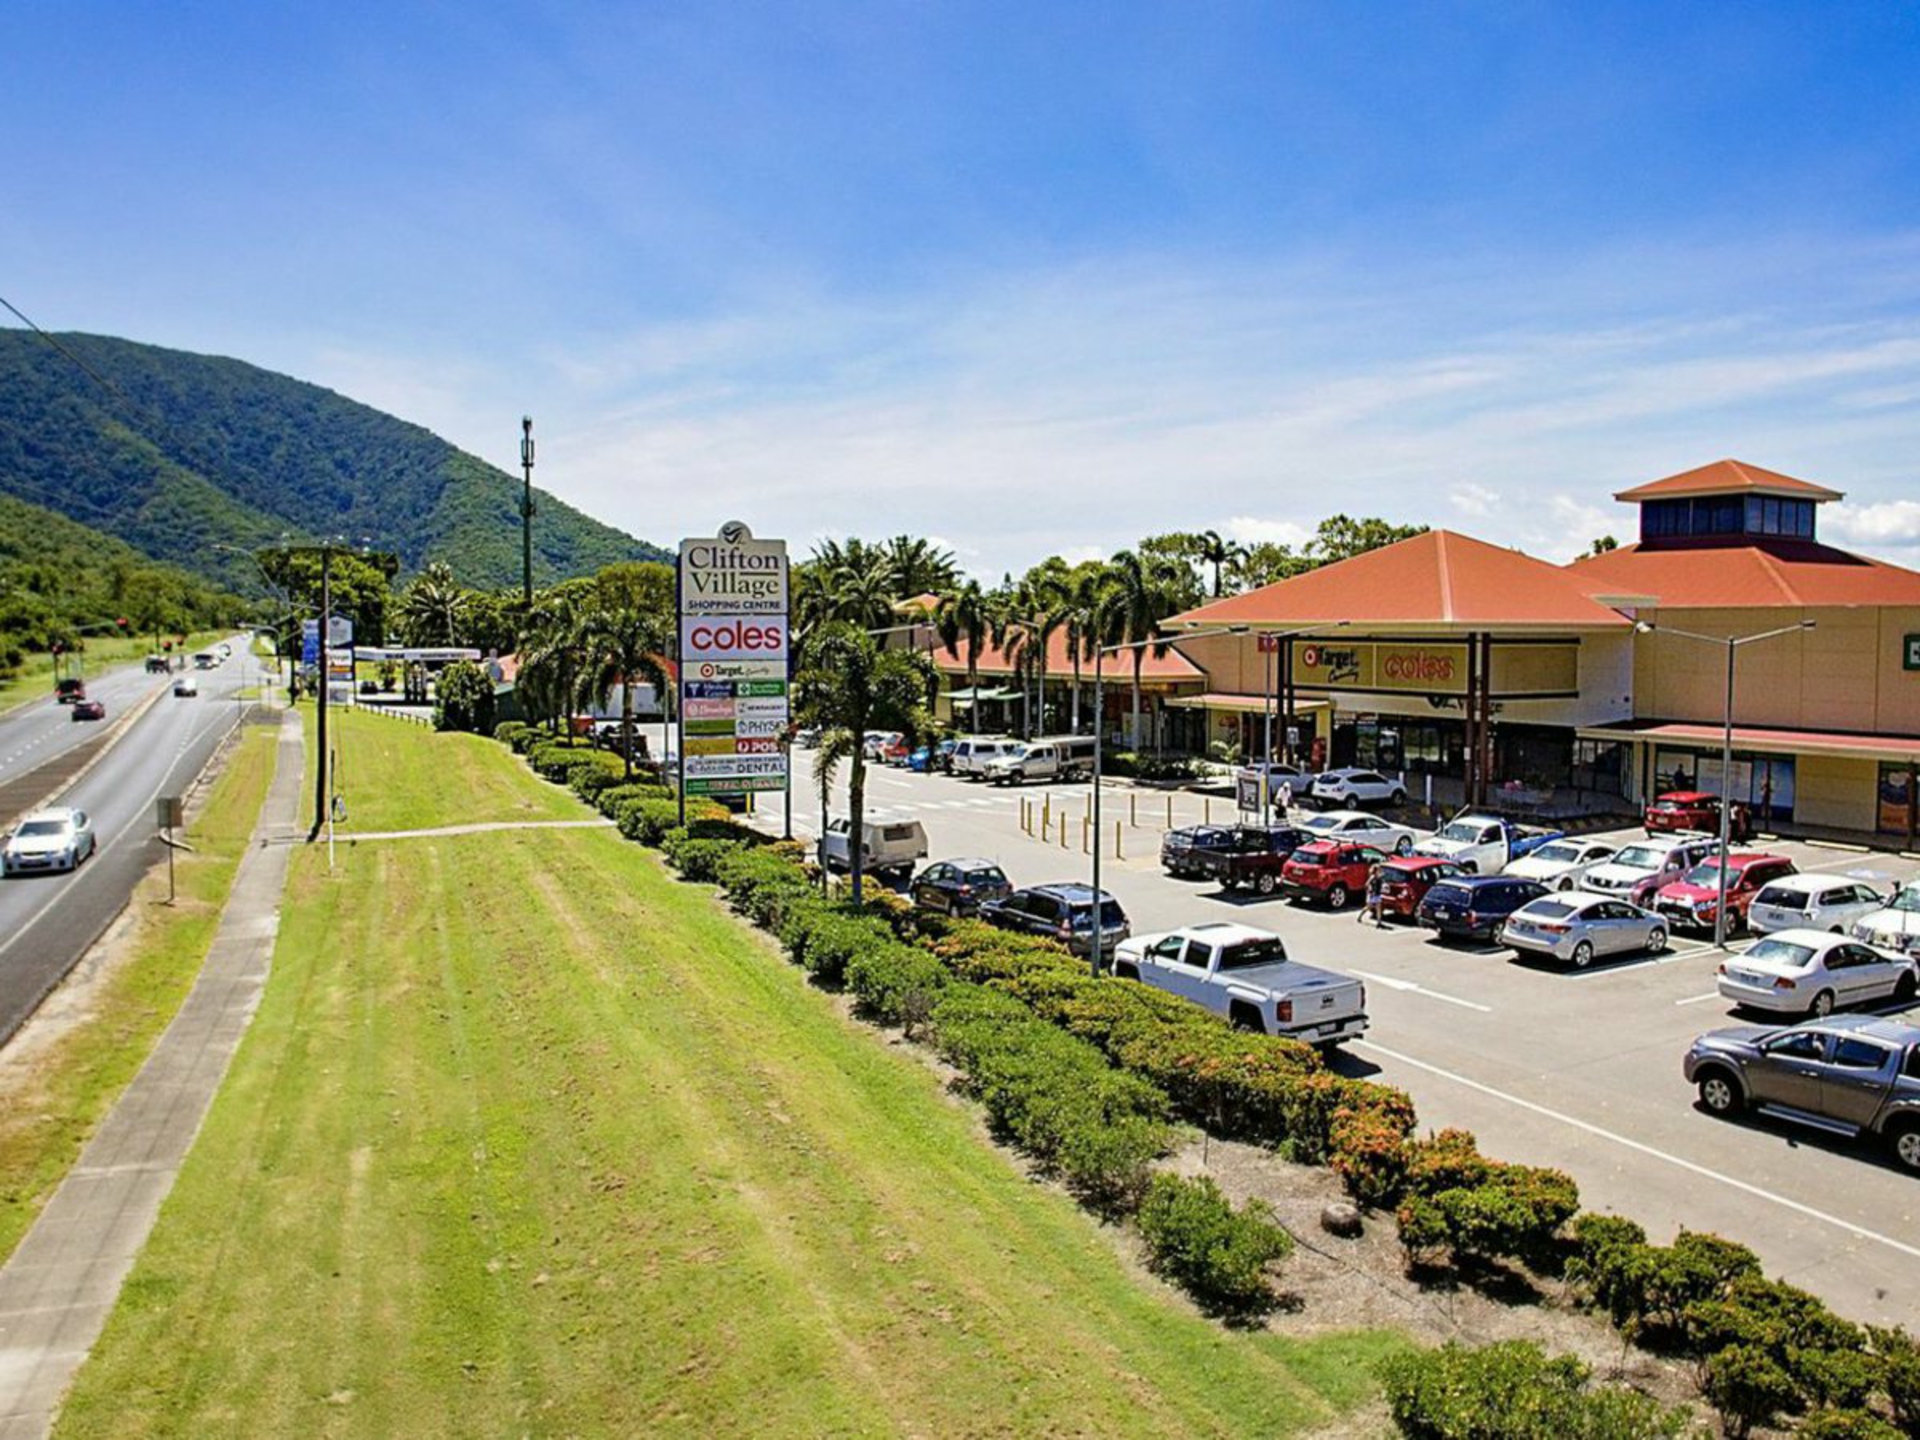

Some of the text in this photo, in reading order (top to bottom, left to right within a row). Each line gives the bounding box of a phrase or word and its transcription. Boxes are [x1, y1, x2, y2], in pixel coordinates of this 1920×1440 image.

[688, 546, 779, 569] Clifton
[690, 571, 779, 599] Village
[688, 600, 780, 609] SHOPPING CENTRE
[691, 619, 781, 650] coles
[1383, 651, 1454, 681] coles
[737, 763, 785, 774] DENTAL
